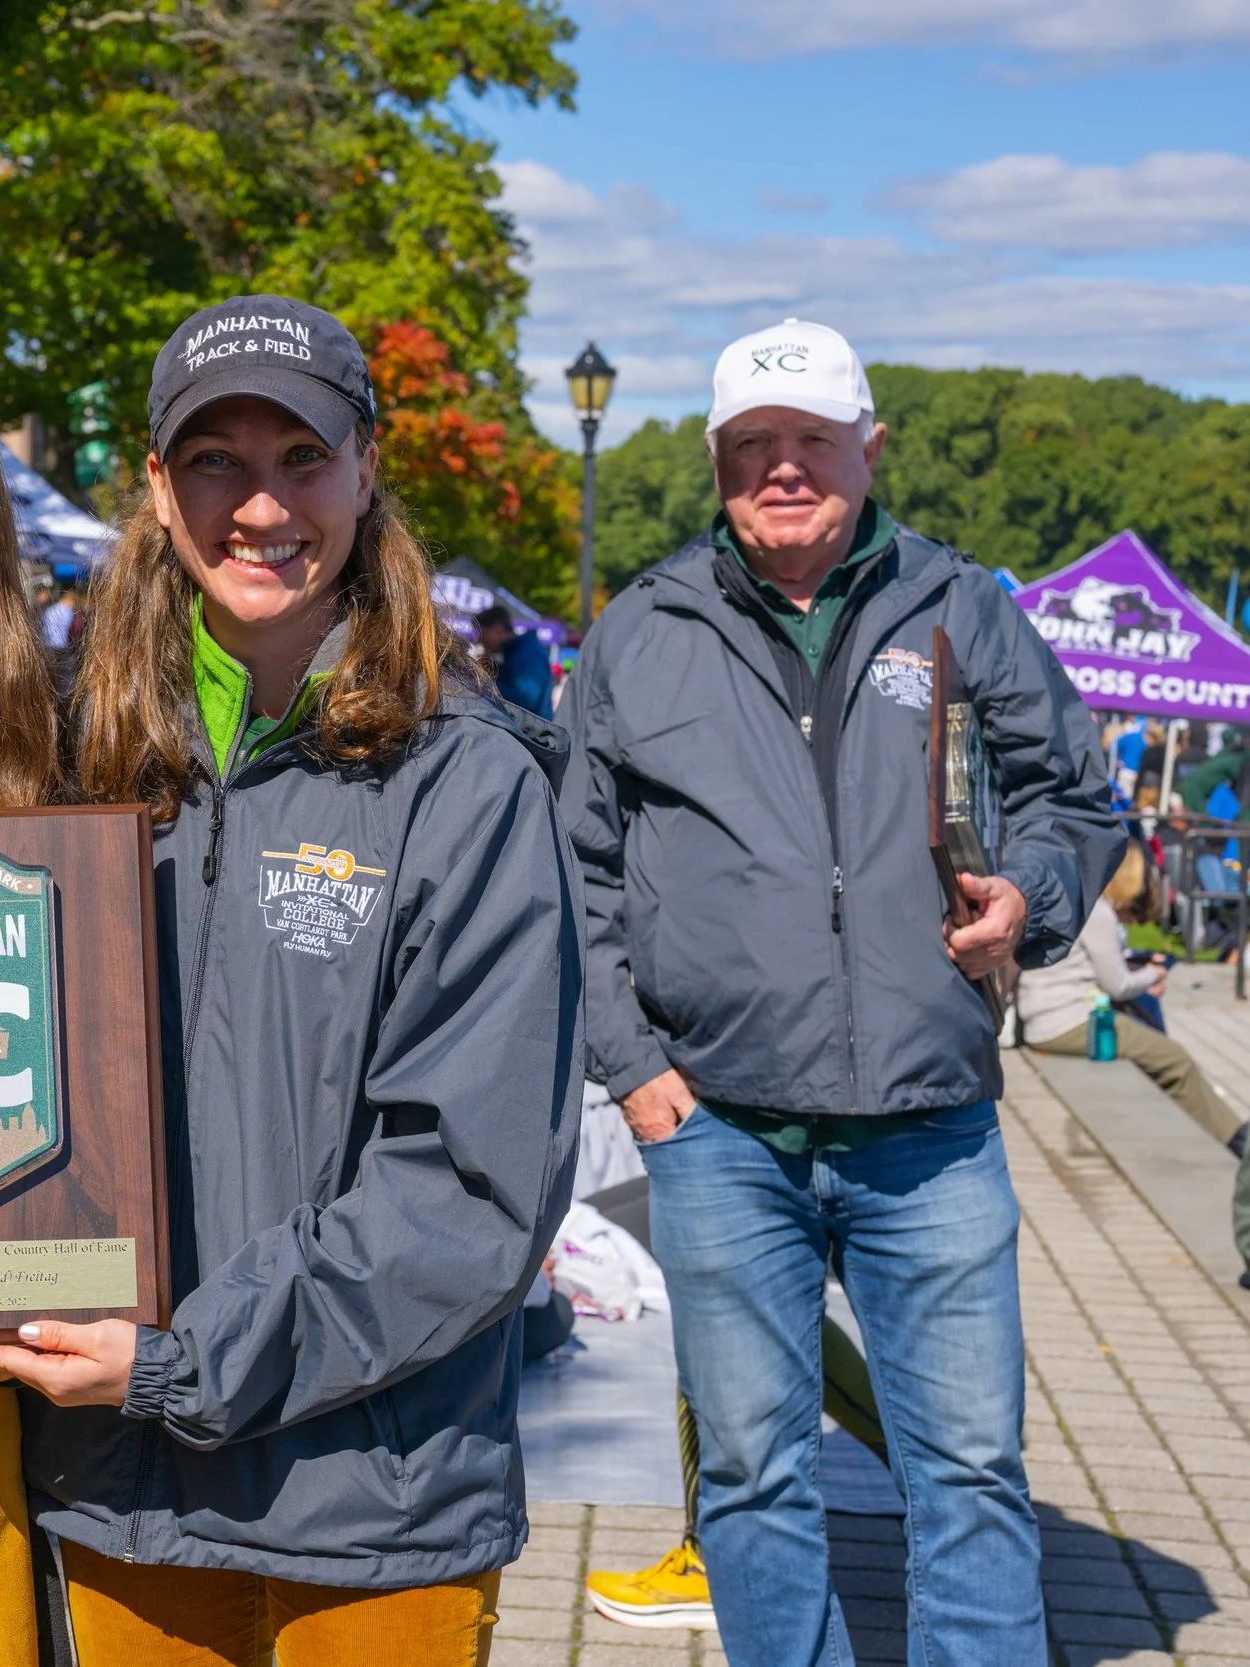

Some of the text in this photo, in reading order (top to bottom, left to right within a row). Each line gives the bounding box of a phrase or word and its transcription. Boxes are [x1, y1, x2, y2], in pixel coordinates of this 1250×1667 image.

[179, 315, 311, 359] MANHATTAN
[185, 338, 311, 372] TRACK & FIELD
[751, 343, 808, 357] MANHATTAN
[750, 352, 807, 376] XC
[1116, 627, 1198, 661] JAY
[871, 663, 933, 688] MANHATTA
[295, 842, 355, 881] 50
[265, 869, 375, 919] MANHATTAN
[281, 900, 349, 920] INVITATIONAL
[283, 908, 345, 931] COLLEGE
[277, 919, 348, 941] VAN CORTLANDT PARK
[291, 931, 326, 949] HOKA
[283, 942, 332, 958] FLY HUMAN FLY
[4, 1244, 49, 1257] Country
[54, 1243, 78, 1254] Hall
[81, 1242, 95, 1253] of
[97, 1242, 128, 1253] Fame
[14, 1271, 59, 1285] Freitag
[7, 1298, 27, 1306] 2022
